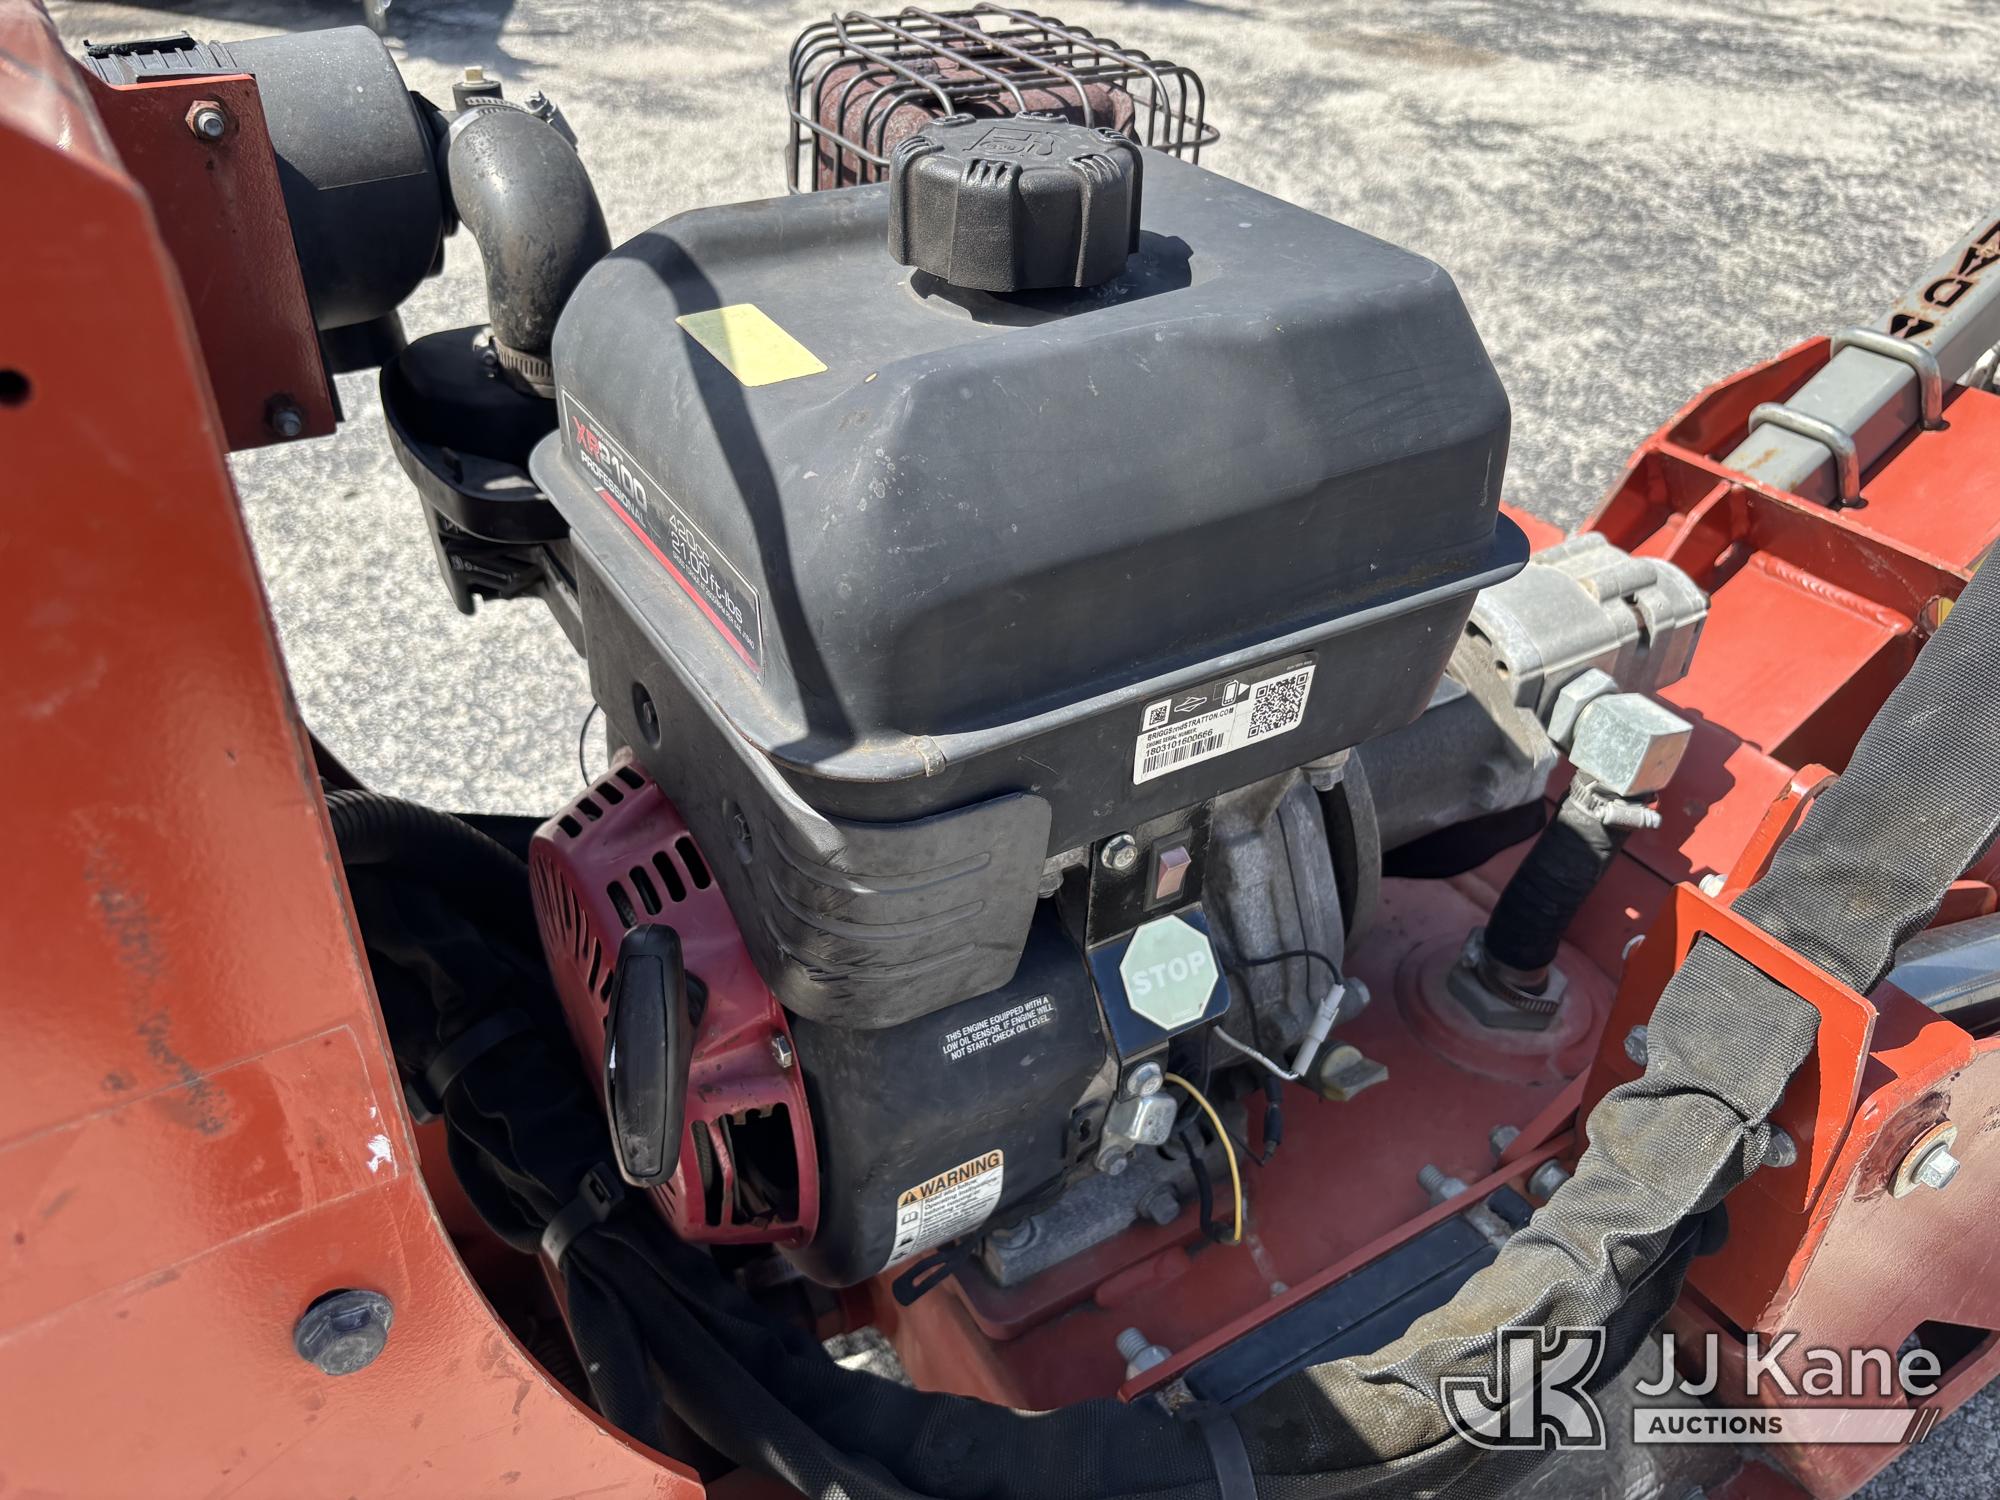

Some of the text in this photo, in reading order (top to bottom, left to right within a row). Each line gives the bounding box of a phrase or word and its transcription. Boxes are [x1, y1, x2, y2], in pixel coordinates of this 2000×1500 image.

[580, 449, 646, 528] PROFESSIONAL
[669, 514, 710, 568] 420cc
[671, 531, 709, 585] 21.00
[709, 573, 743, 624] ft-lbs
[1146, 729, 1213, 757] 1803101600666
[1132, 950, 1206, 996] STOP
[943, 1042, 959, 1054] LOW
[959, 1037, 971, 1047] OIL
[1003, 1021, 1011, 1030] IF
[1011, 1010, 1036, 1026] ENGINE
[1036, 1003, 1054, 1015] WILL
[945, 996, 1049, 1043] THIS ENGINE EQUIPPED WITH A
[951, 1048, 966, 1060] NOT
[992, 1028, 1016, 1043] CHECK
[1016, 1023, 1028, 1033] OIL
[920, 1153, 1000, 1197] WARNING
